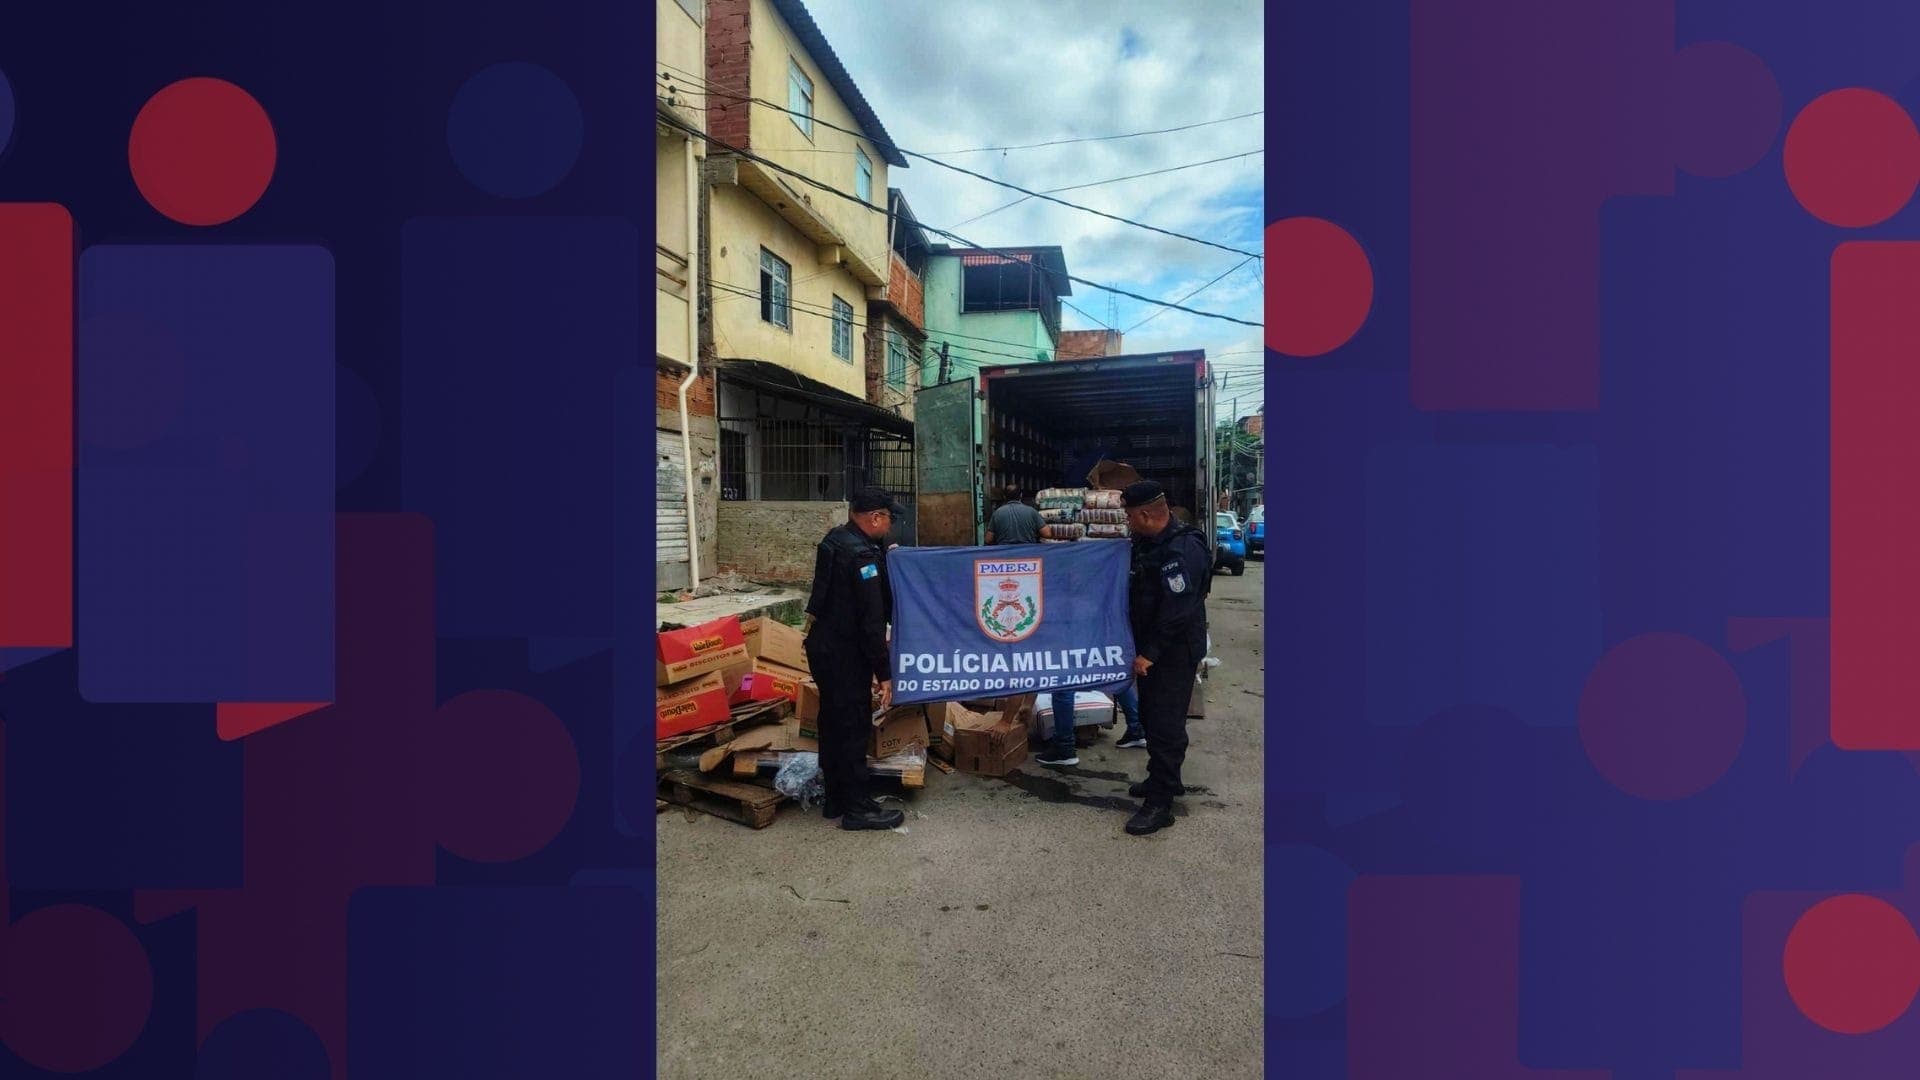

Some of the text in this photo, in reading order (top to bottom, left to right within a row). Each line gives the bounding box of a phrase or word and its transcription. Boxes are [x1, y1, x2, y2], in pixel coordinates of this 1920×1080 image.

[980, 562, 1037, 574] PMERJ
[899, 645, 1126, 674] POLÍCIA MILITAR
[897, 671, 1127, 692] DO ESTADO DO RIO DE JANEIRO
